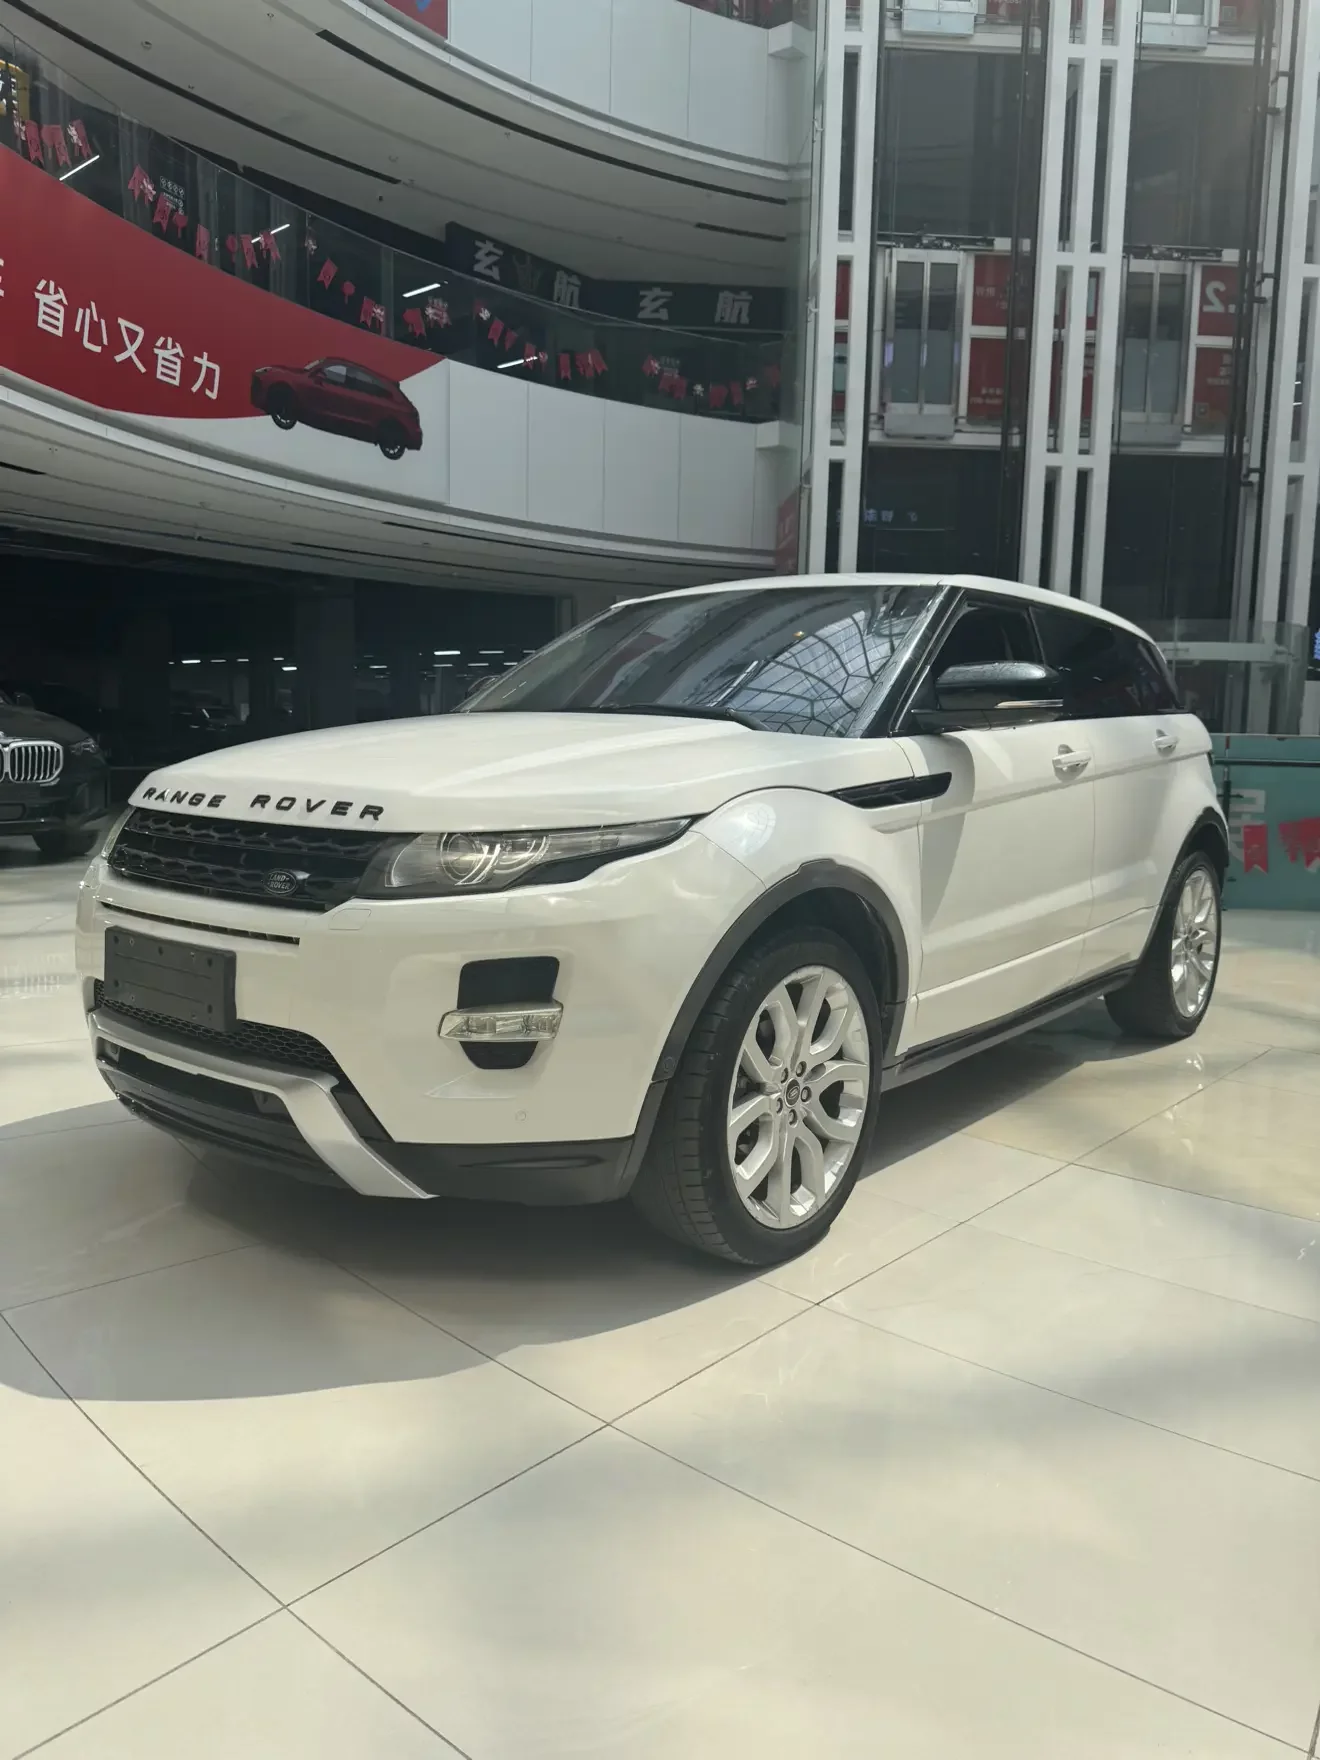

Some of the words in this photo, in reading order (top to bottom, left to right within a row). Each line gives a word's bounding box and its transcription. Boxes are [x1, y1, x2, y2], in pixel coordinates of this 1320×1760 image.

[34, 279, 221, 400] 省心又省力
[142, 787, 227, 809] RANGE
[250, 794, 385, 821] ROVER
[269, 881, 290, 890] ROVER
